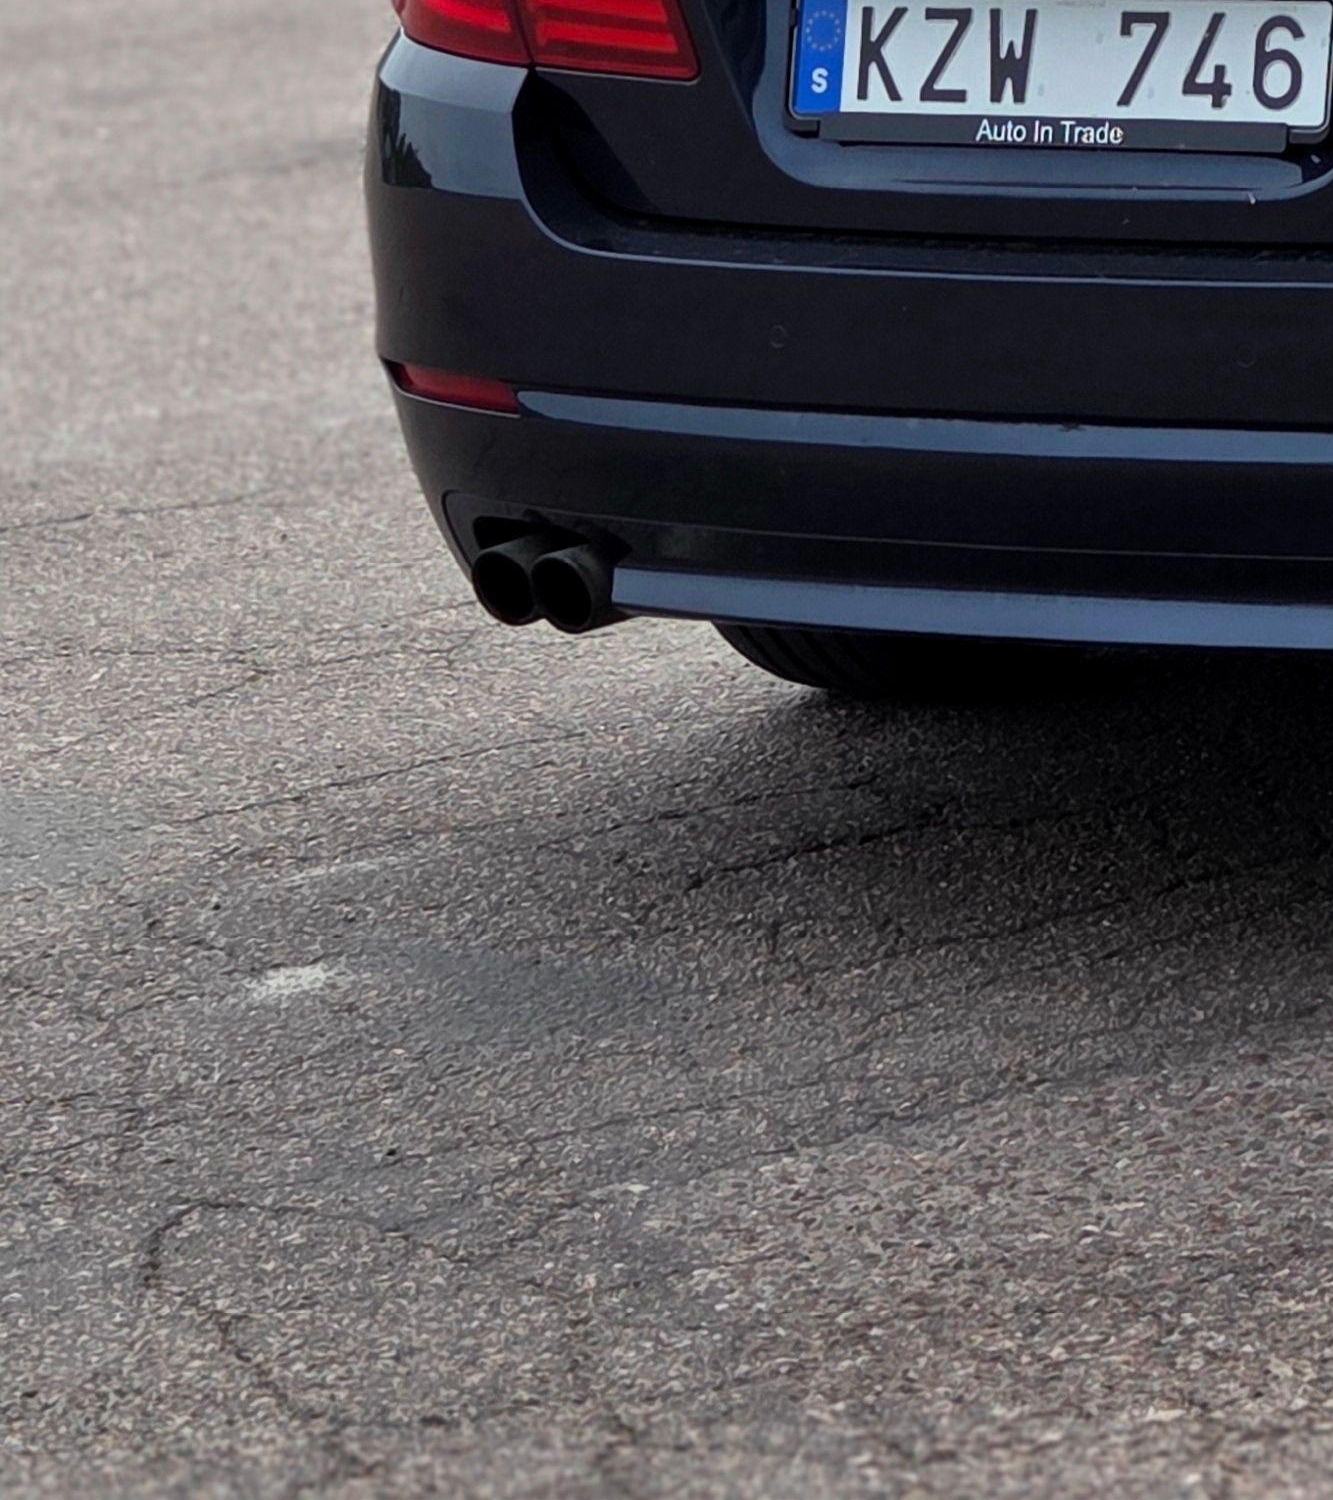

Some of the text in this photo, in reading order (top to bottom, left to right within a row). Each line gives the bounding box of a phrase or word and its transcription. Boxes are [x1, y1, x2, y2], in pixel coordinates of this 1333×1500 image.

[857, 6, 1305, 111] KZW 746
[811, 67, 829, 94] S
[976, 118, 1124, 145] Auto In Trade
